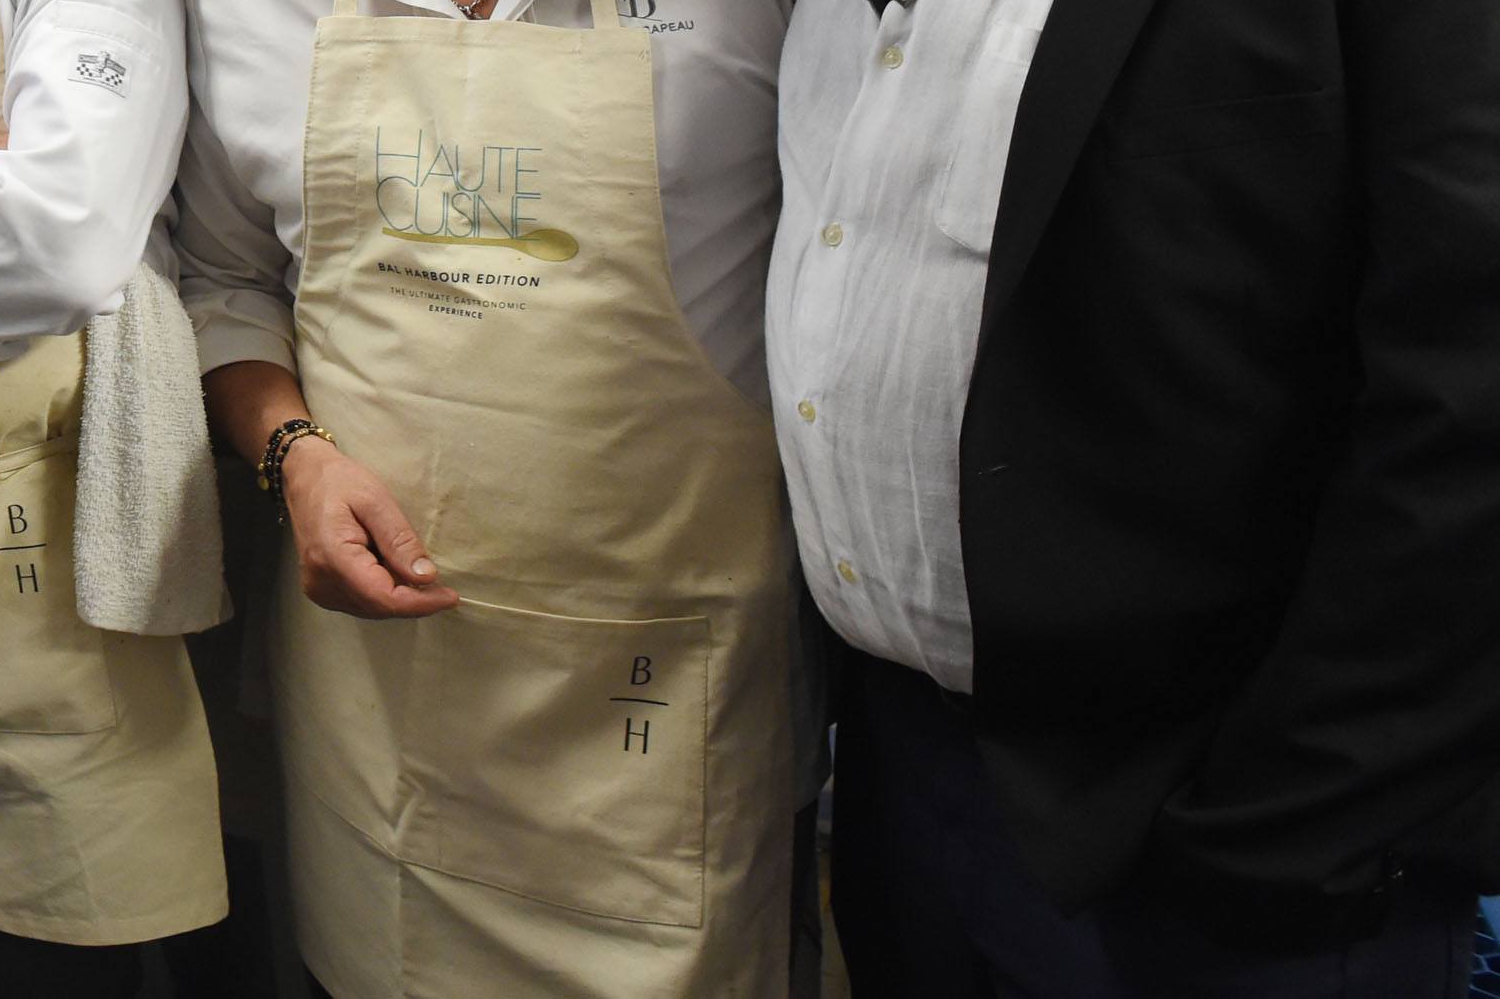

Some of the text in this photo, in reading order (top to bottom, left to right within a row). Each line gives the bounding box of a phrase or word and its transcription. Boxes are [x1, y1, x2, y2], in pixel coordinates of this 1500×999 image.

[644, 20, 694, 34] APEAU
[376, 126, 542, 195] HAUTE
[376, 176, 541, 241] CUISINE
[378, 262, 540, 287] BAL HARBOUR EDITION
[390, 287, 527, 310] THE ULTIMATE GASTRONOMIC
[429, 304, 483, 319] EXPERIENCE
[8, 504, 28, 534] B
[15, 563, 38, 594] H
[630, 656, 651, 685] B
[624, 717, 649, 755] H
